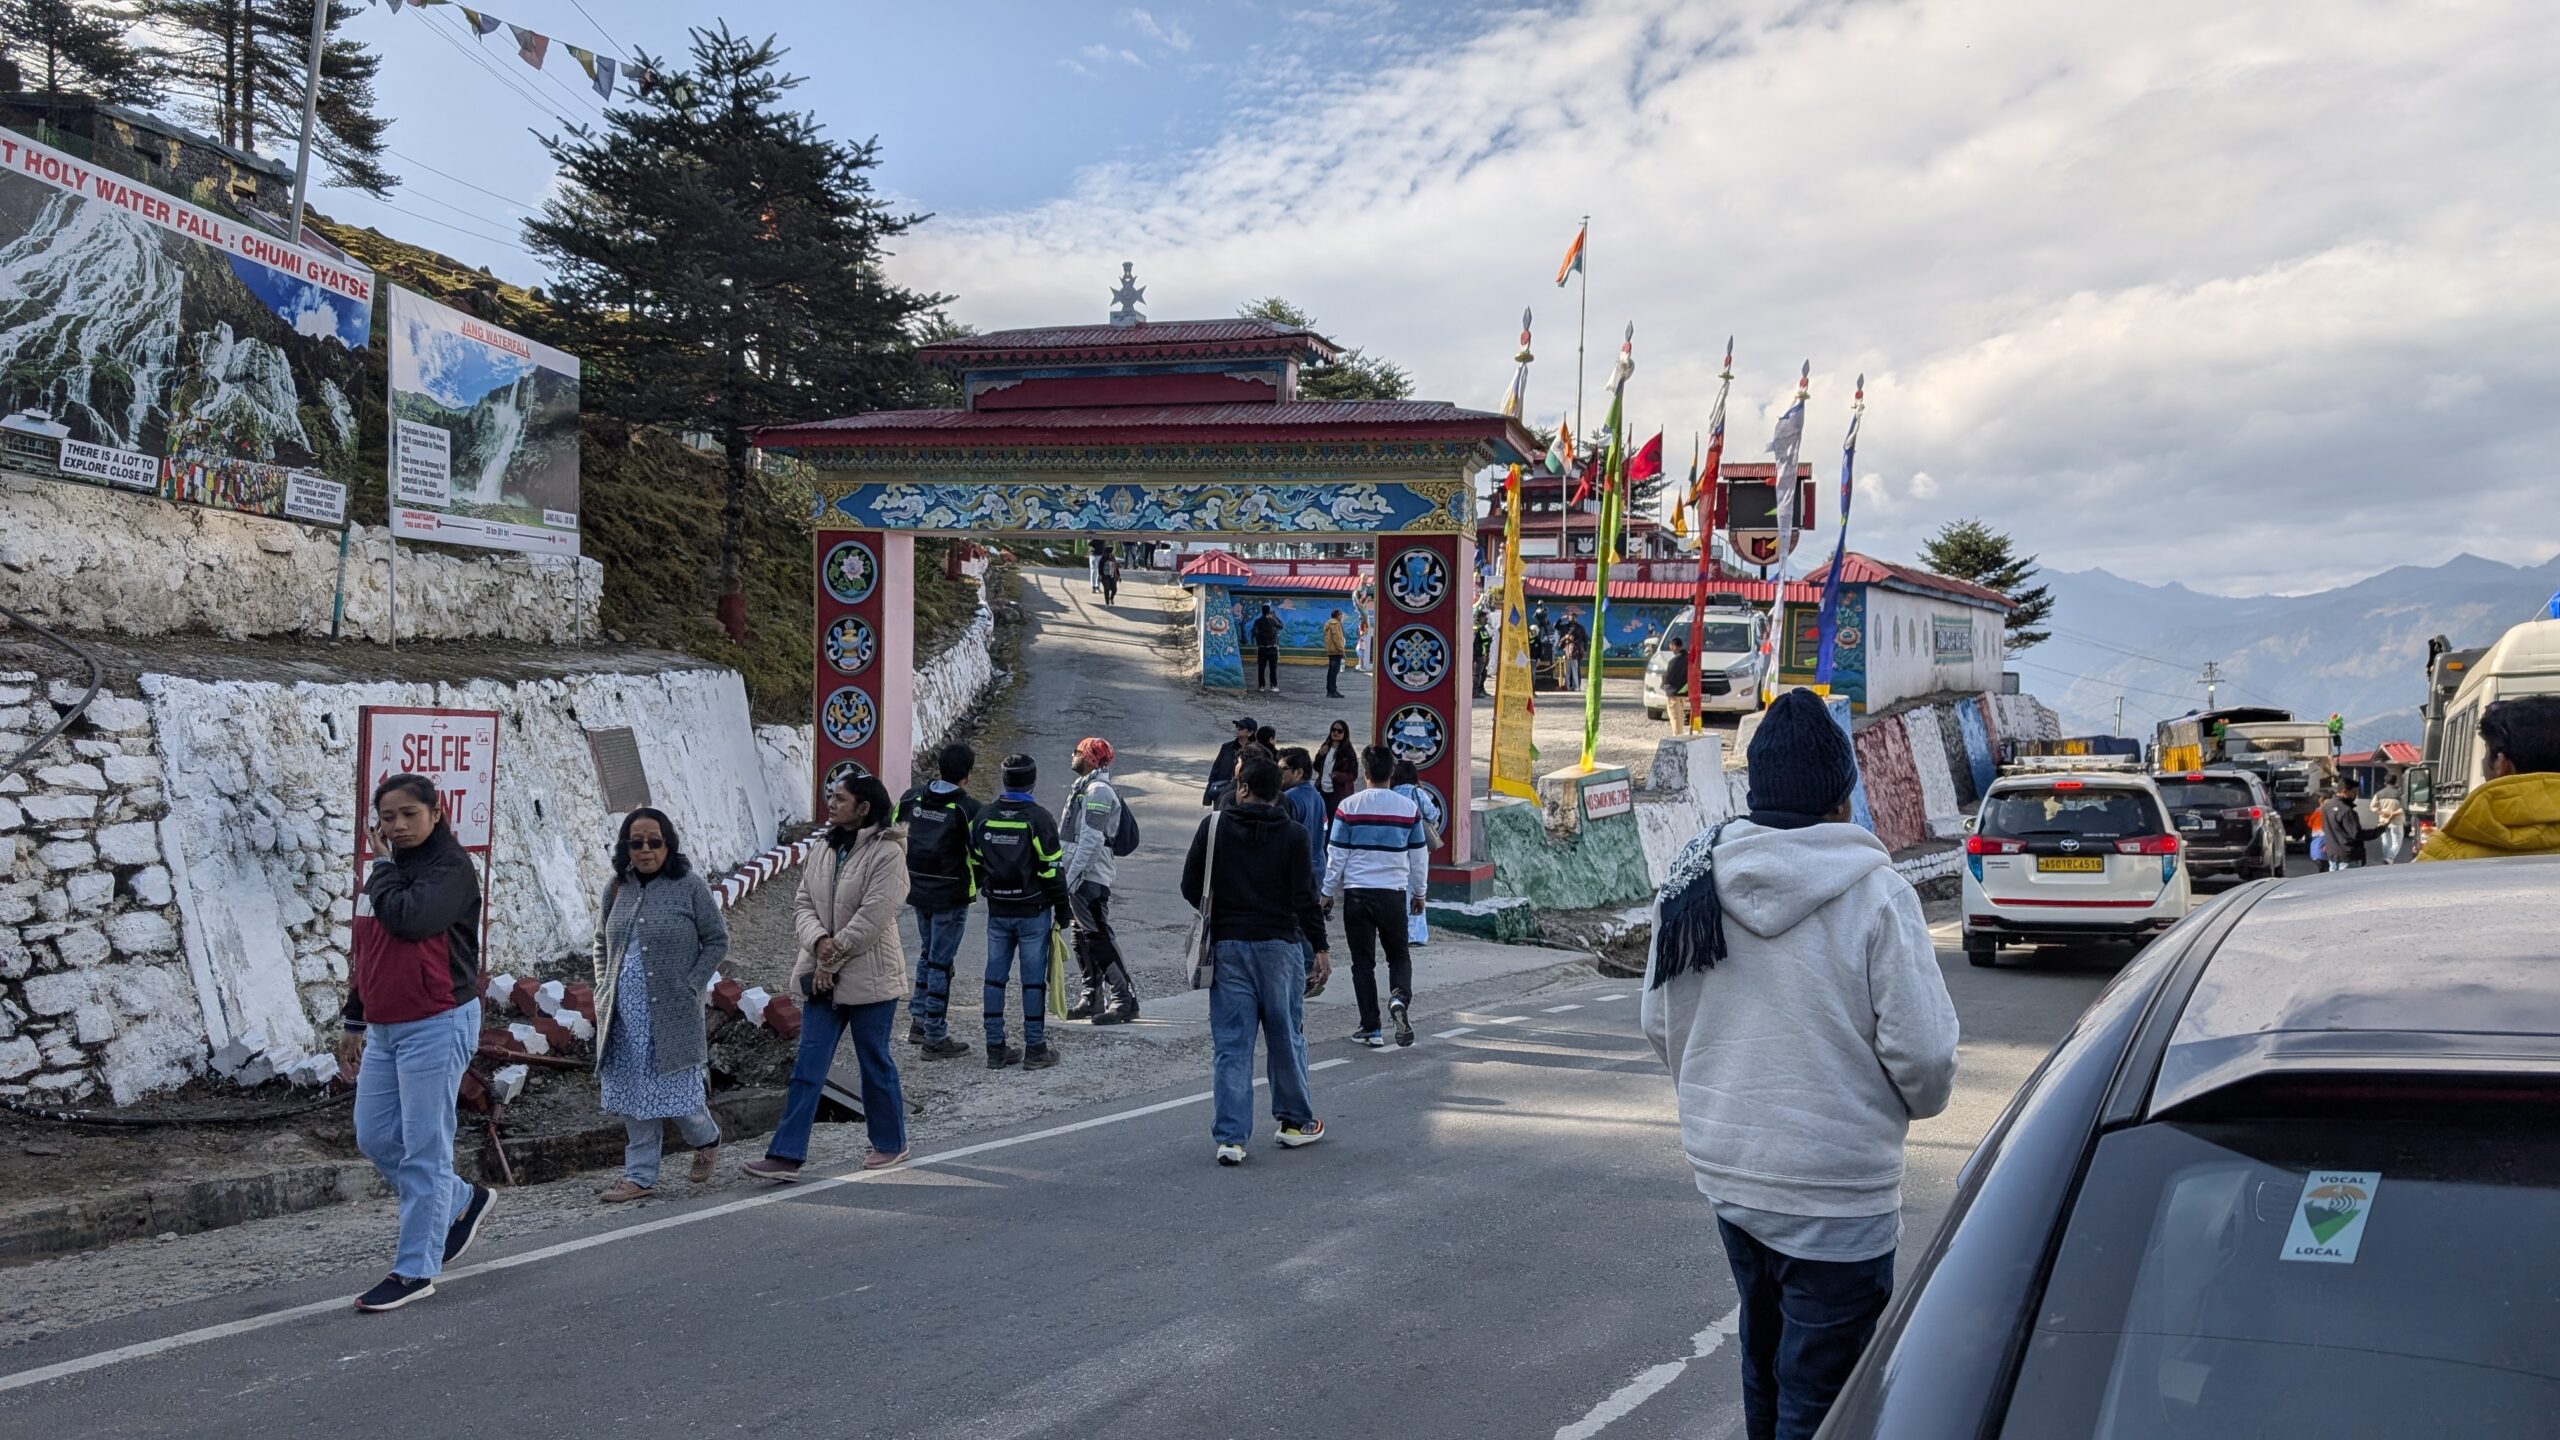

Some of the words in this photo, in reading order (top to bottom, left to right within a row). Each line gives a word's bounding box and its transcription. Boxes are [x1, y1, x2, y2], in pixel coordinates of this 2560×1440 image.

[25, 149, 89, 190] HOLY
[96, 177, 170, 223] WATER
[177, 208, 223, 245] FALL
[241, 235, 302, 274] CHUMI
[307, 261, 369, 300] GYATSE
[461, 320, 484, 339] JANG
[486, 329, 530, 356] WATERFALL
[63, 456, 108, 474] EXPLORE
[109, 465, 141, 481] CLOSE
[142, 472, 155, 483] BY
[67, 443, 100, 459] THERE
[100, 450, 111, 461] IS
[112, 453, 119, 463] A
[121, 454, 140, 467] LOT
[141, 459, 154, 470] TO
[292, 476, 315, 487] CONTACT
[400, 733, 471, 773] SELFIE
[2045, 860, 2102, 869] AS01RC4519
[2319, 1175, 2367, 1184] VOCAL
[2295, 1246, 2344, 1257] LOCAL
